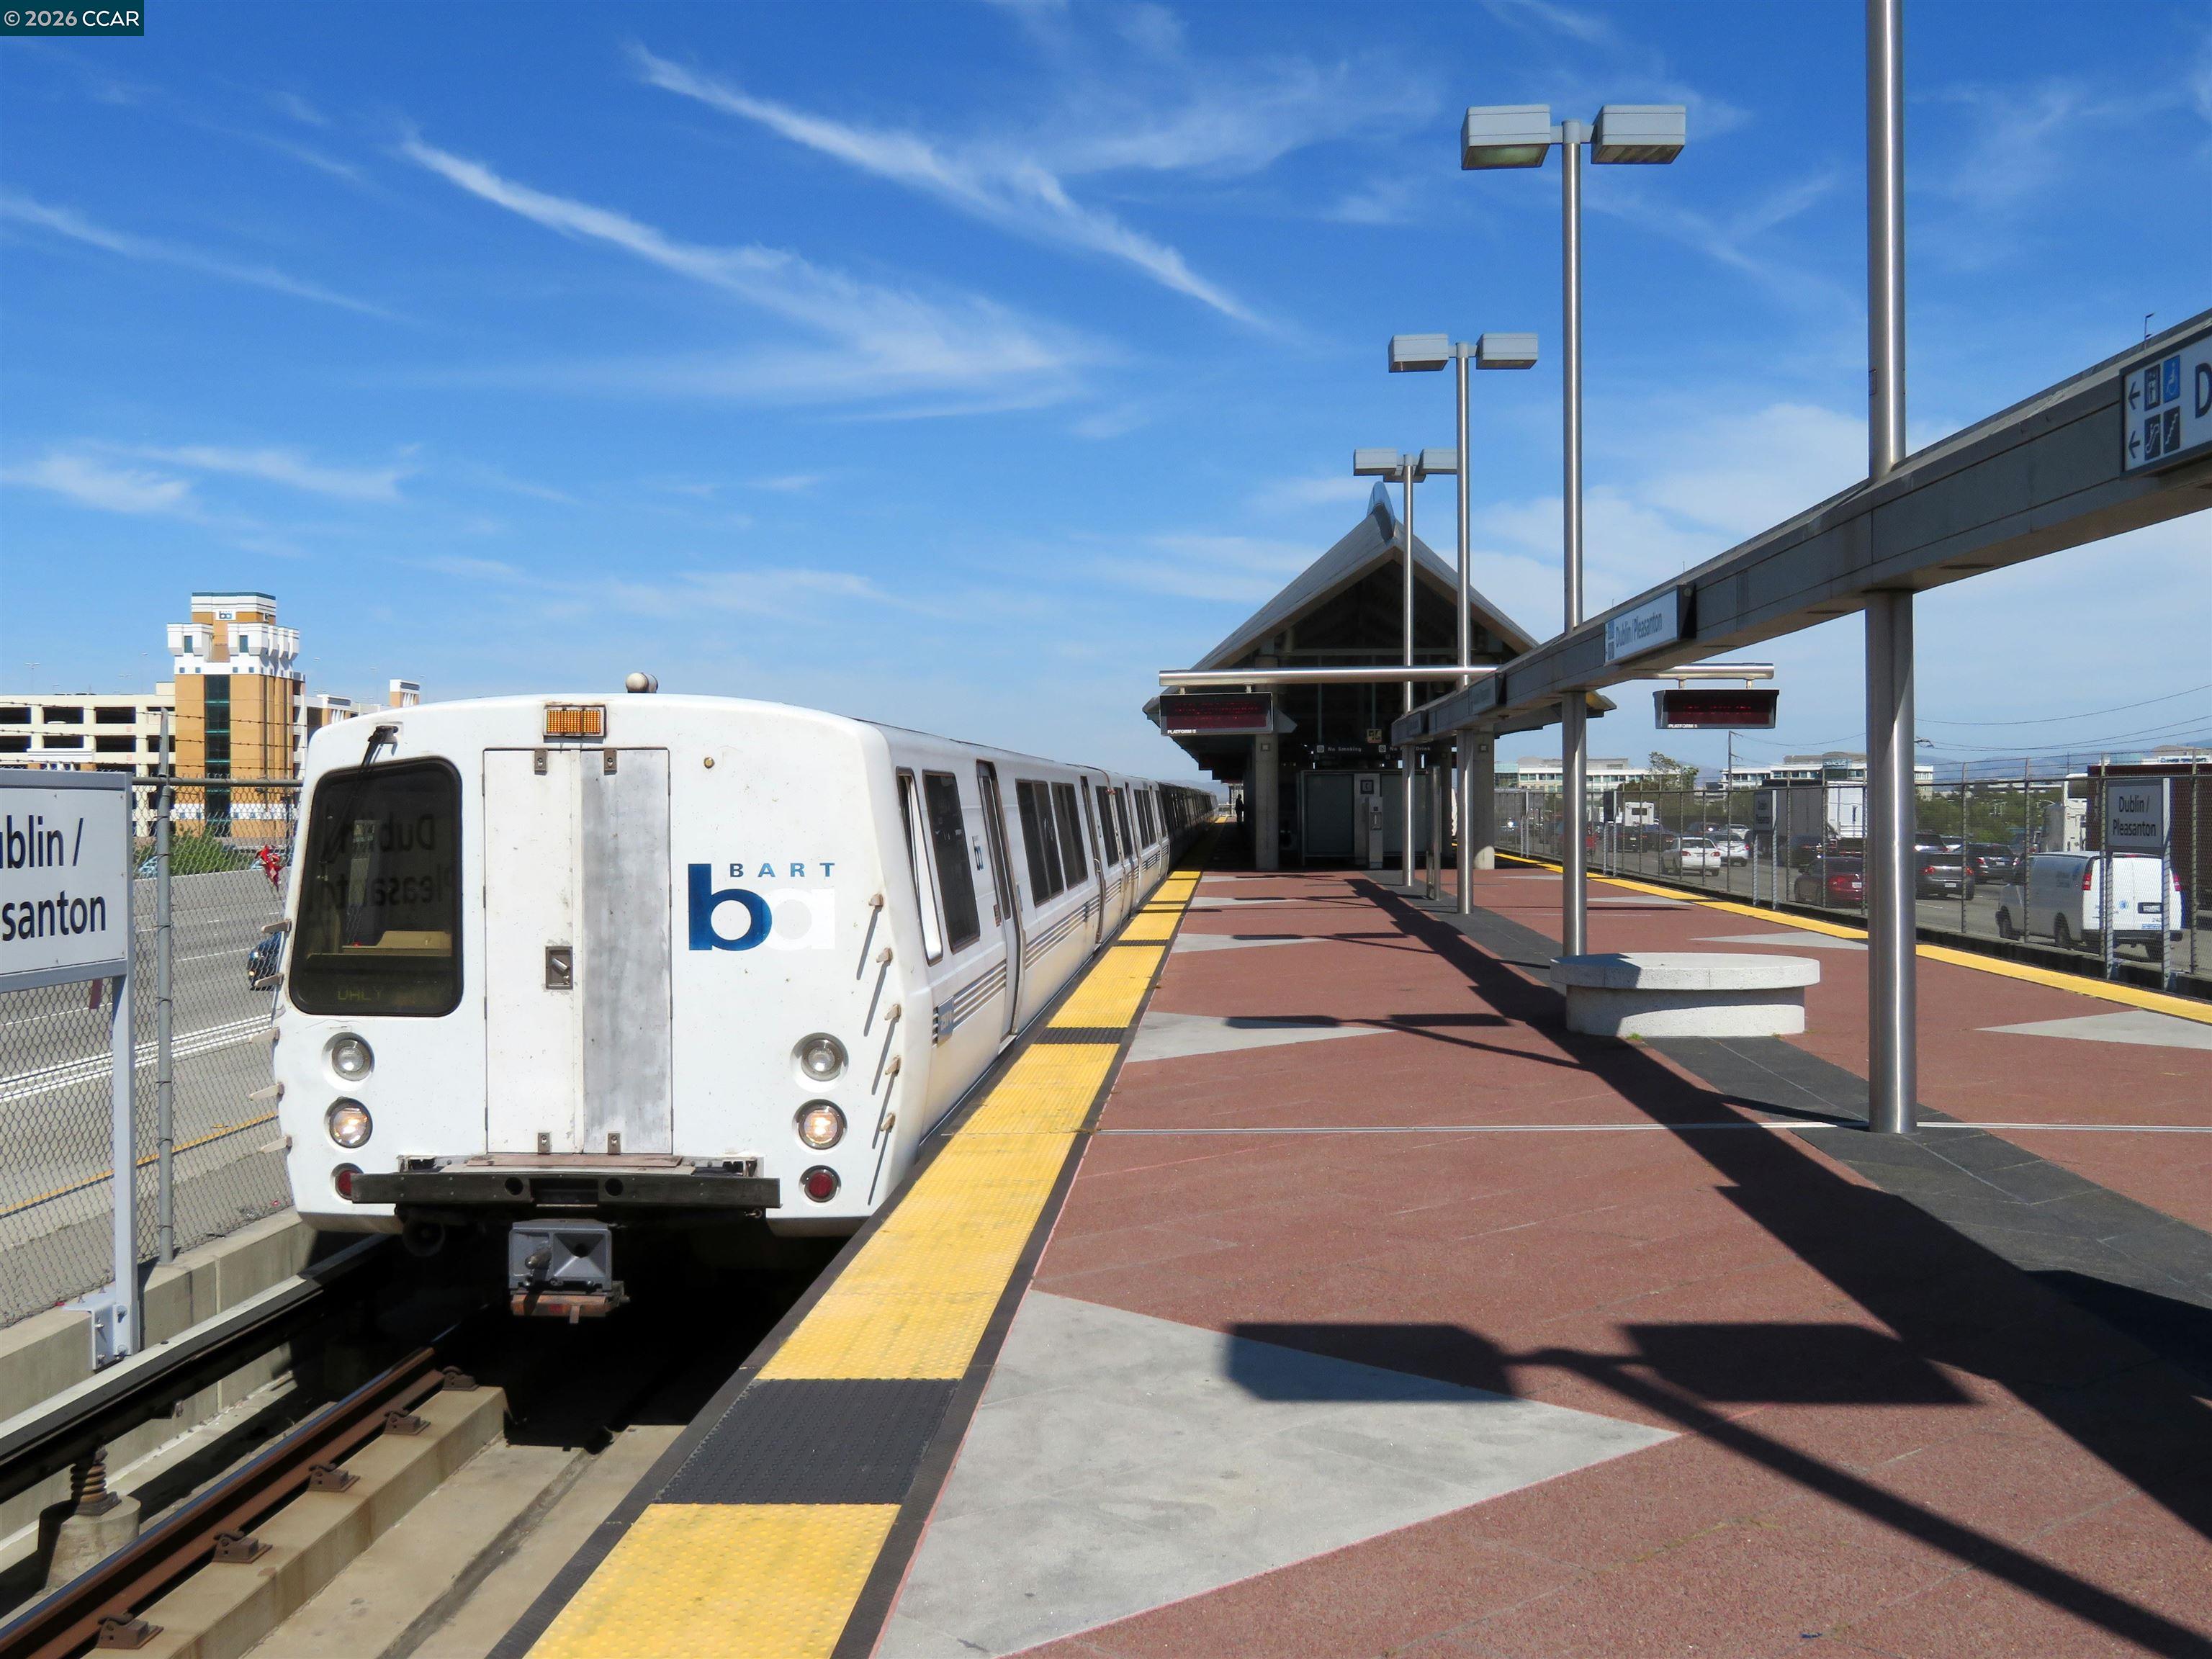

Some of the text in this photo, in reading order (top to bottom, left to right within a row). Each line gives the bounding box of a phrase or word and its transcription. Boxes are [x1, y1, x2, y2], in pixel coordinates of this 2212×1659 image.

[2195, 362, 2212, 419] D
[1616, 621, 1631, 648] Dublin
[1634, 612, 1663, 641] Pleasanton
[2119, 794, 2150, 813] Dublin /
[2113, 817, 2157, 837] Pleasanton
[0, 814, 84, 869] blin /
[729, 863, 835, 878] BART
